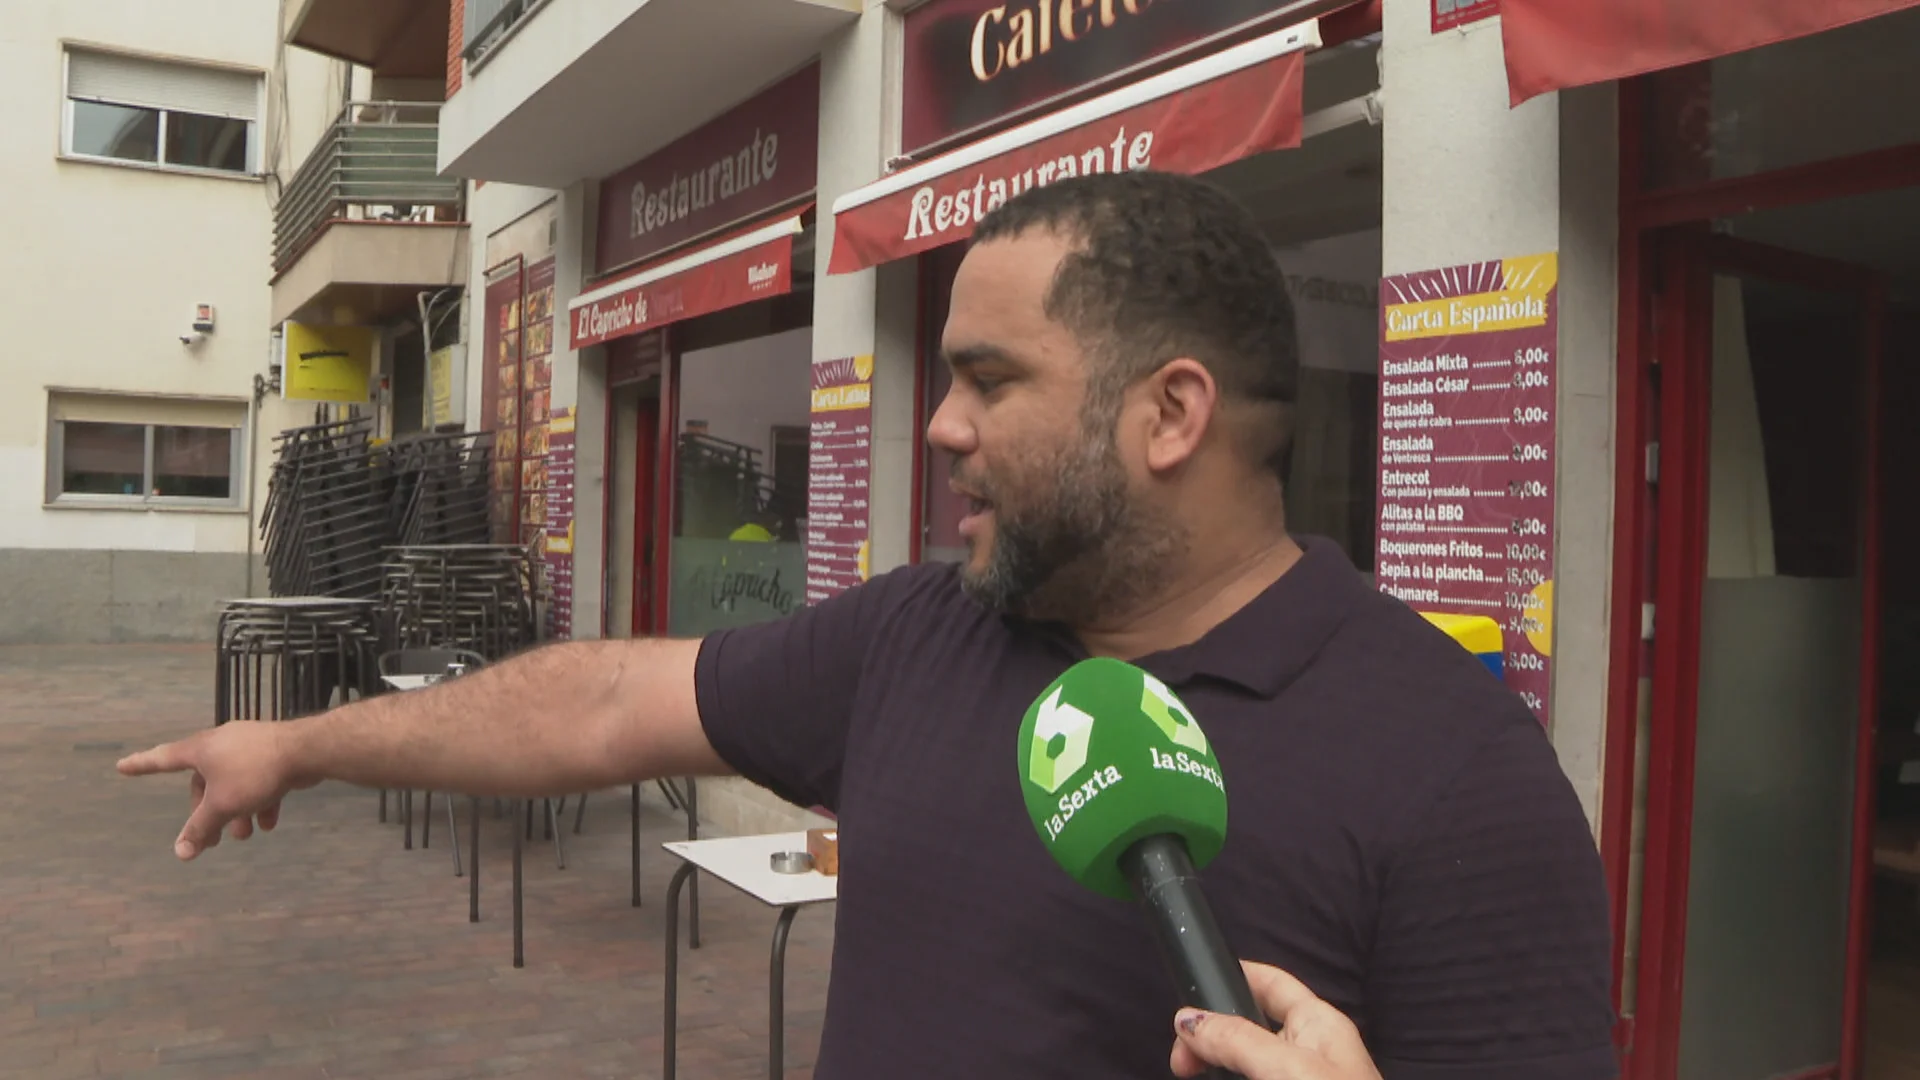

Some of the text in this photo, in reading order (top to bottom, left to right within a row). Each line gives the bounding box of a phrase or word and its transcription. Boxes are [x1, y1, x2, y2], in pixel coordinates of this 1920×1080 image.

[630, 127, 778, 239] Restaurante
[577, 307, 590, 340] El
[590, 296, 633, 341] Capricho
[635, 292, 647, 324] de
[1388, 295, 1544, 333] Carta Española
[1383, 356, 1434, 376] Ensalada
[1436, 353, 1468, 371] Mixta
[1383, 377, 1434, 396] Ensalada
[1436, 375, 1469, 393] César
[1383, 399, 1434, 417] Ensalada
[1383, 418, 1392, 429] de
[1394, 418, 1416, 431] queso
[1418, 416, 1428, 428] de
[1429, 415, 1452, 427] cabra
[1383, 433, 1434, 451] Ensalada
[1382, 453, 1392, 464] de
[1393, 452, 1431, 464] Ventresca
[1382, 469, 1430, 485] Entrecot
[1382, 486, 1396, 497] Con
[1397, 486, 1426, 500] patatas
[1427, 488, 1432, 500] y
[1433, 485, 1470, 497] ensalada
[1381, 503, 1464, 520] Alitas a la BBQ
[1381, 522, 1395, 531] con
[1396, 520, 1425, 534] patatas
[1380, 538, 1448, 559] Boquerones
[1449, 540, 1483, 558] Fritos
[1380, 560, 1410, 581] Sepia
[1413, 565, 1420, 578] a
[1422, 561, 1433, 579] la
[1435, 563, 1484, 584] plancha
